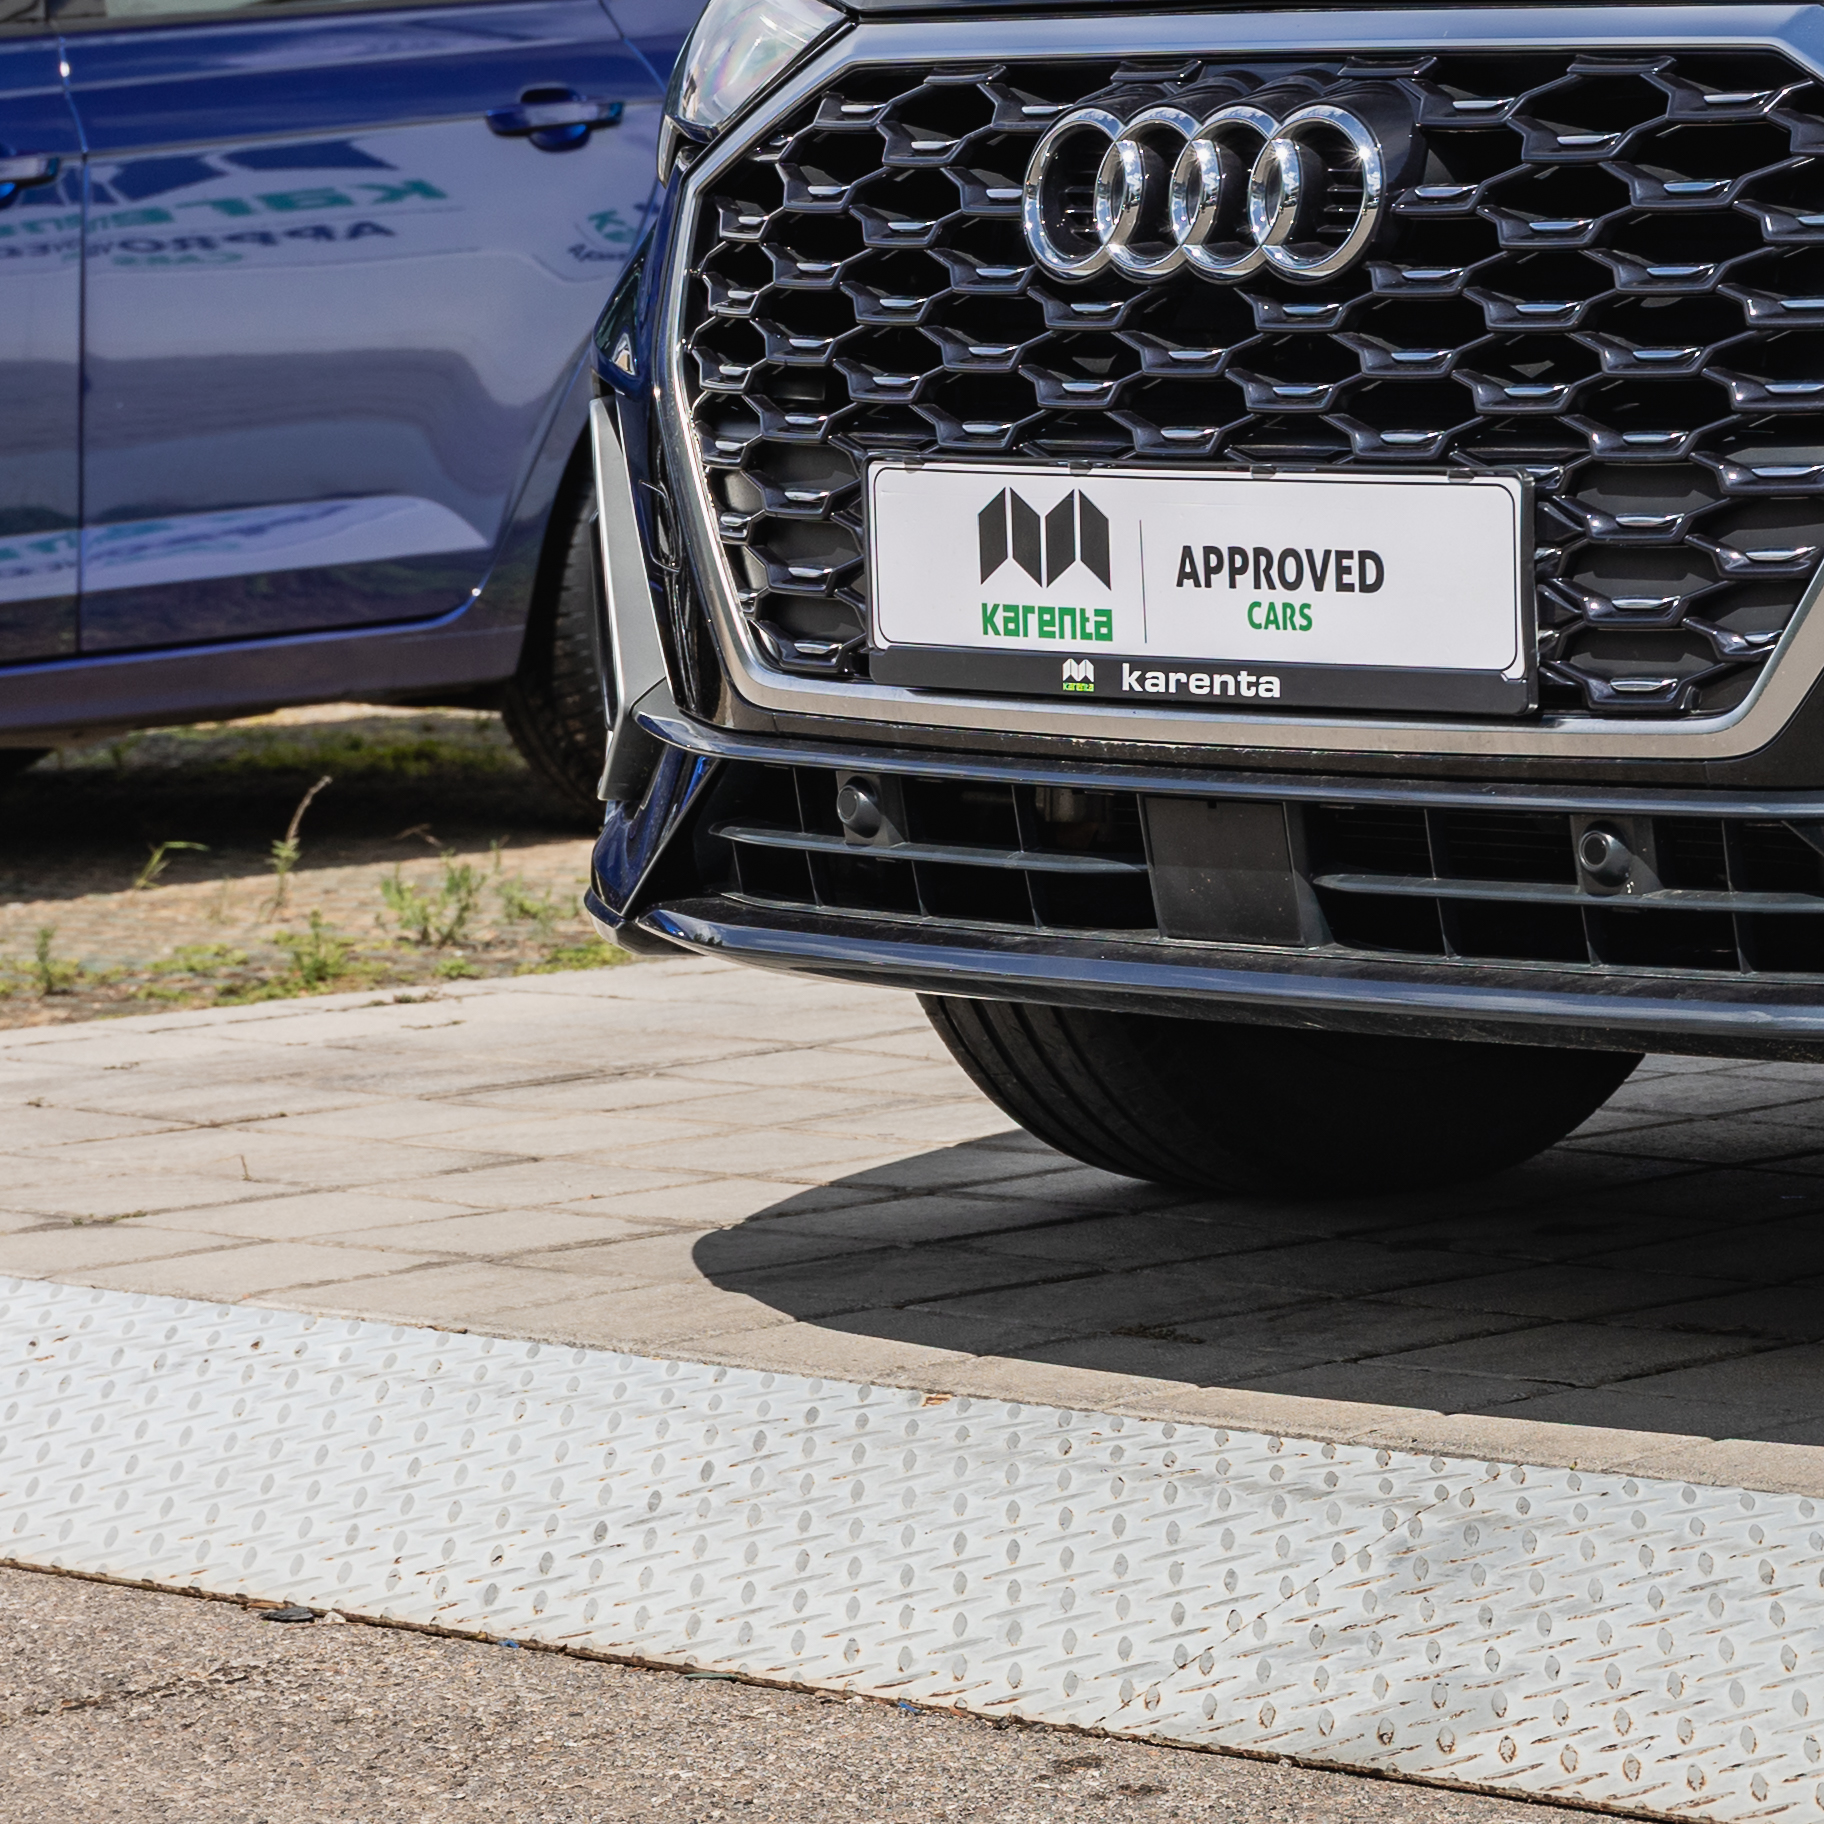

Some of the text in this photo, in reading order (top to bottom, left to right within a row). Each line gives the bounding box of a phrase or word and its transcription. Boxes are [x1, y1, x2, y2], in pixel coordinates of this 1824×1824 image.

[1175, 545, 1385, 594] APPROVED
[981, 602, 1113, 642] karenta
[1247, 600, 1313, 632] CARS
[1121, 662, 1282, 698] karenta
